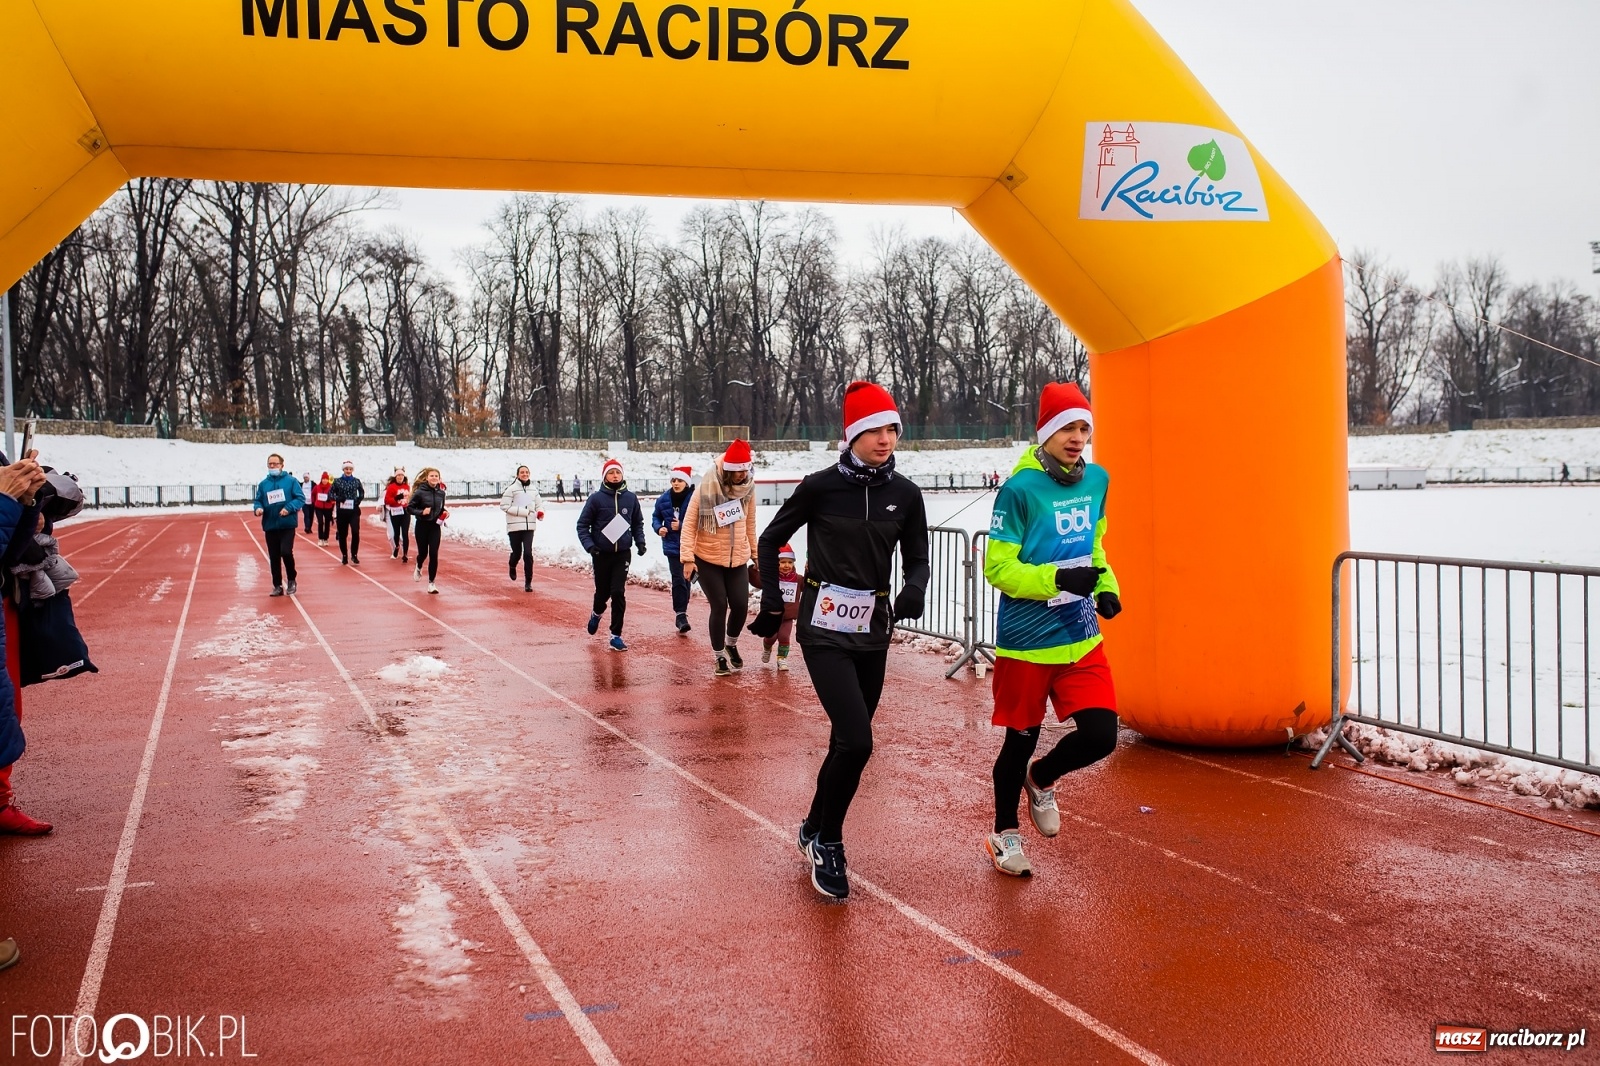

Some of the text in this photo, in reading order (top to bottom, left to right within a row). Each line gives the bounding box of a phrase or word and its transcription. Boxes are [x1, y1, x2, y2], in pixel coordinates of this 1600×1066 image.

[241, 0, 910, 70] MIASTO RACIBÓRZ
[1100, 160, 1258, 219] Racibórz
[725, 506, 741, 518] 064
[836, 603, 870, 619] 007
